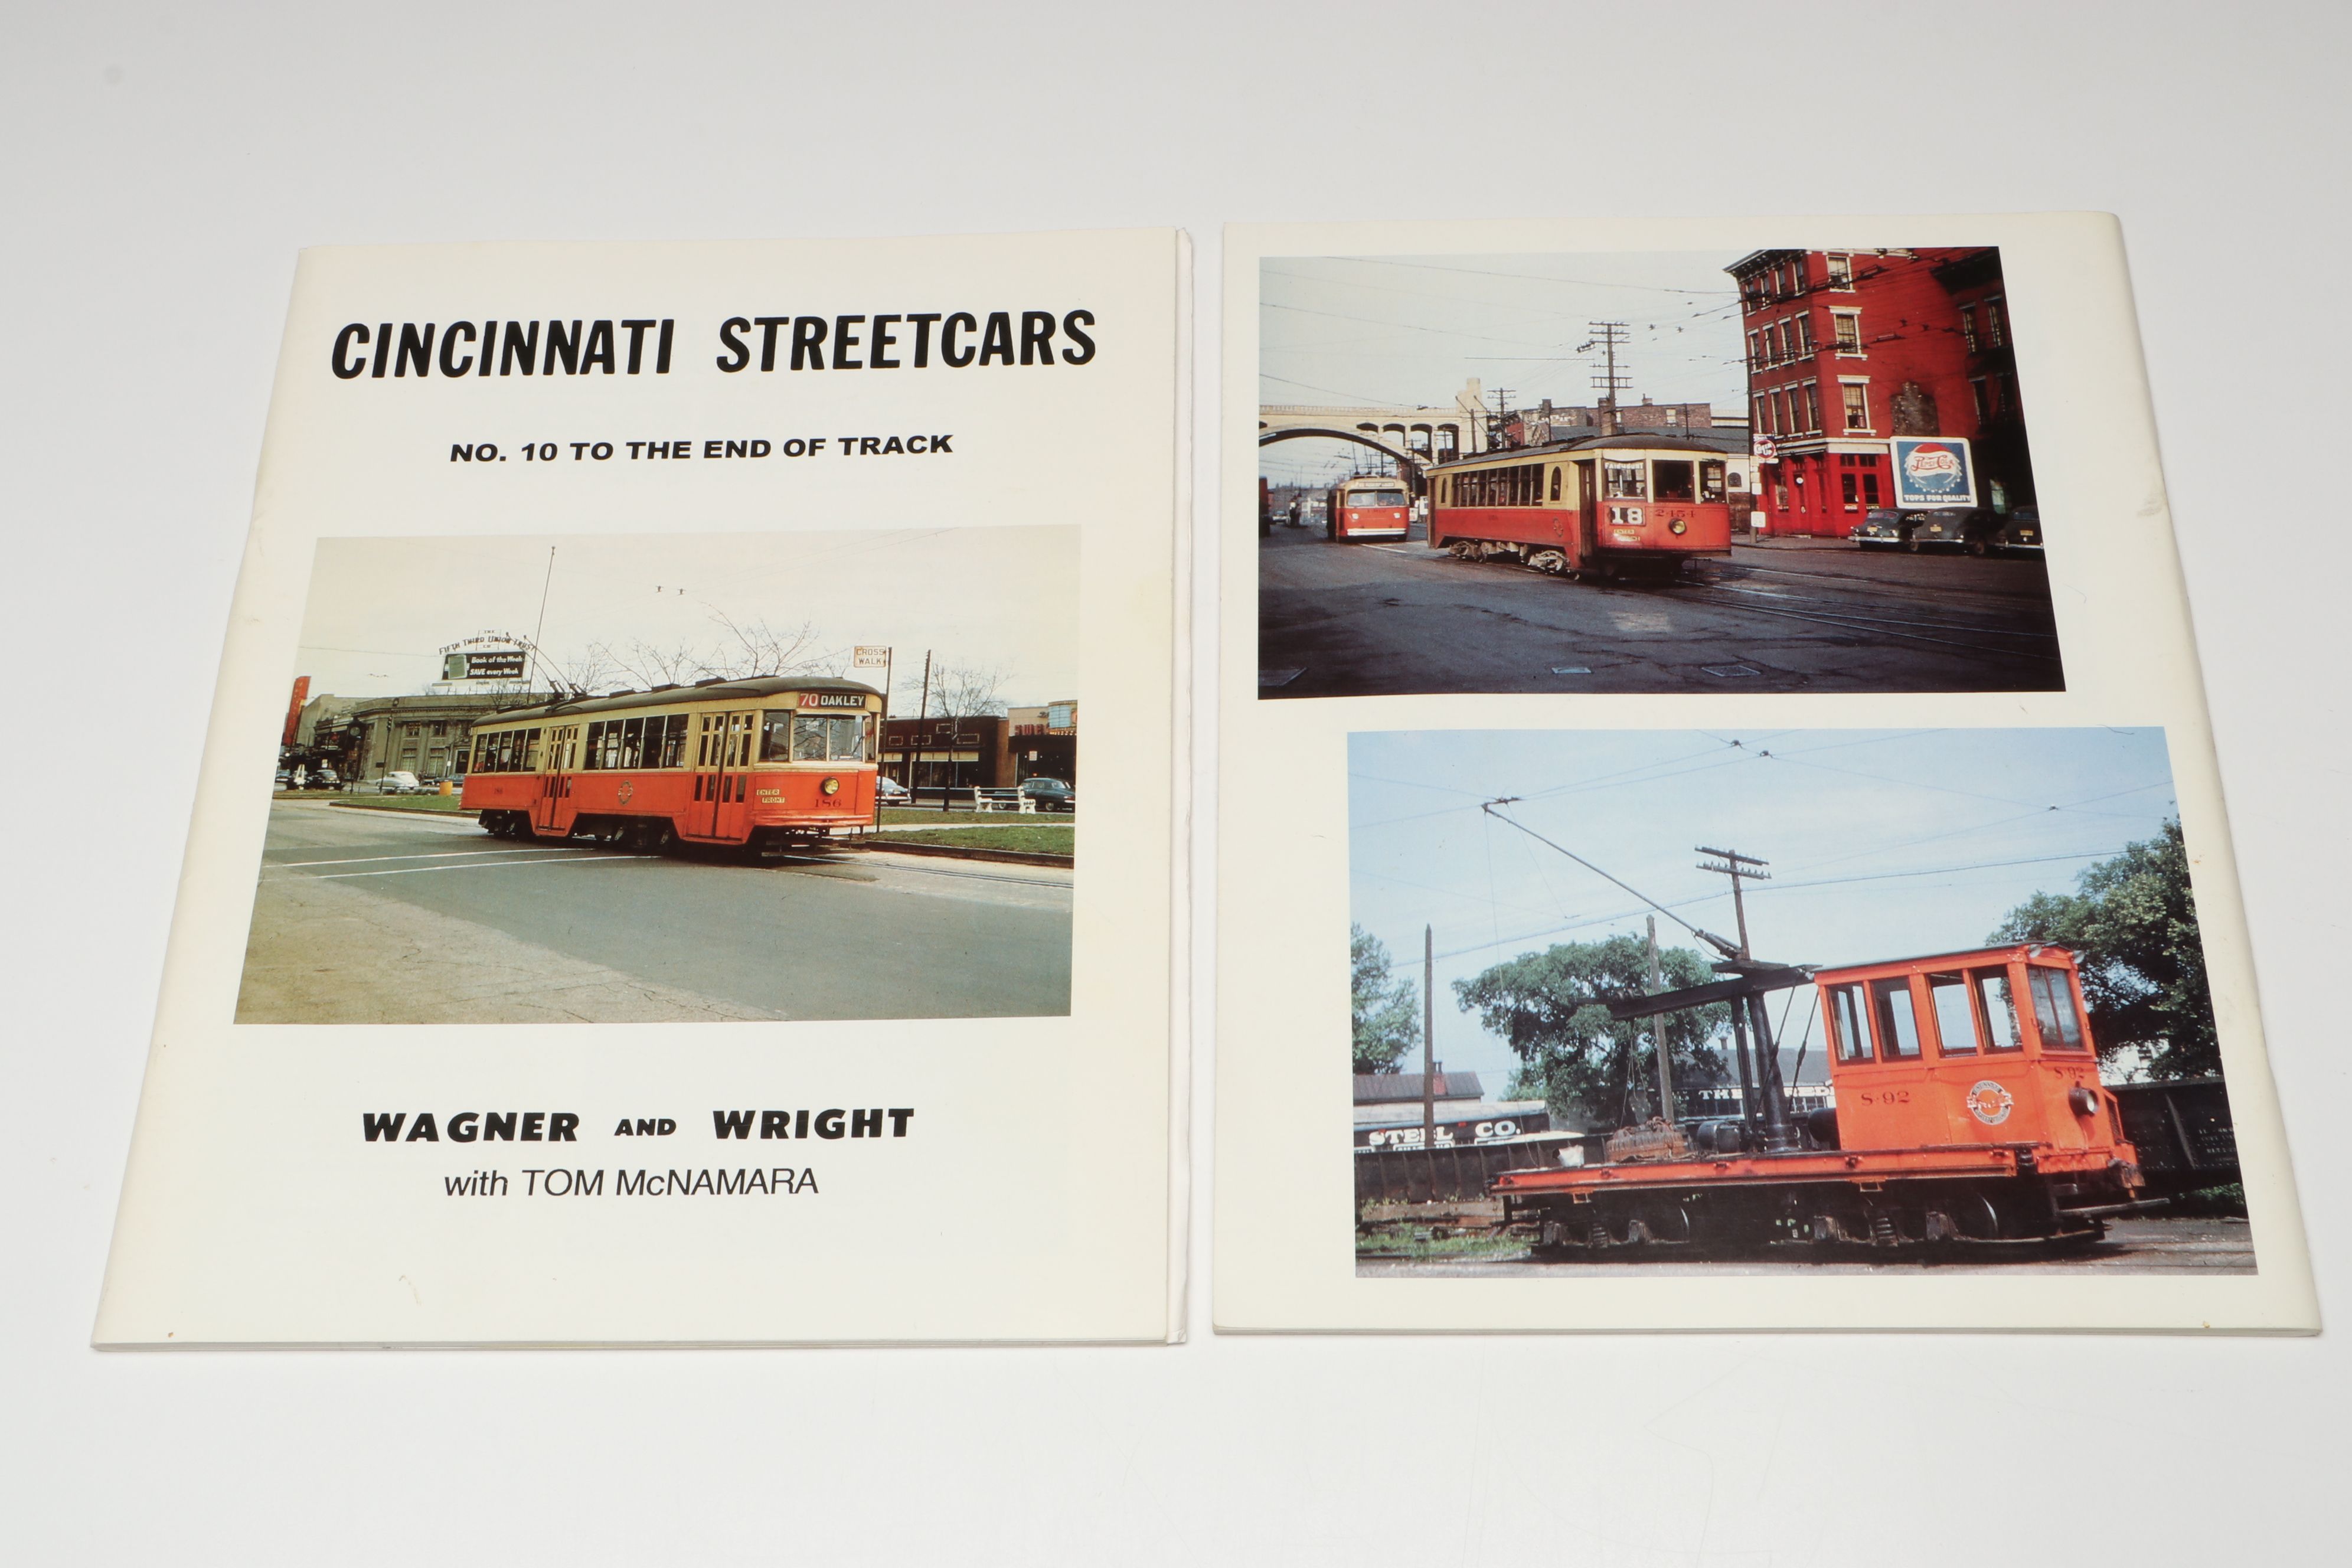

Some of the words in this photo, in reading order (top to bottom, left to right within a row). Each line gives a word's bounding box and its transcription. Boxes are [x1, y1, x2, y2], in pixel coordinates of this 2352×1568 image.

[332, 319, 674, 379] CINCINNATI
[717, 310, 1095, 373] STREETCARS
[451, 444, 505, 461] NO.
[522, 443, 557, 460] 10
[570, 443, 613, 460] TO
[626, 442, 691, 459] THE
[704, 440, 770, 458] END
[784, 439, 825, 456] OF
[838, 435, 952, 455] TRACK
[1942, 494, 1971, 502] QUALITY
[1611, 507, 1643, 524] 18
[439, 642, 460, 655] FIFTH
[462, 636, 485, 646] THIRD
[488, 635, 512, 644] UNION
[513, 638, 537, 651] TRUST
[800, 693, 819, 707] 70
[820, 695, 865, 708] OAKLEY
[815, 799, 842, 808] 186
[364, 1113, 579, 1142] WAGNER
[615, 1119, 676, 1135] AND
[713, 1109, 913, 1139] WRIGHT
[1475, 1120, 1521, 1138] CO.
[445, 1171, 507, 1195] with
[522, 1170, 603, 1195] TOM
[617, 1168, 818, 1195] McNAMARA
